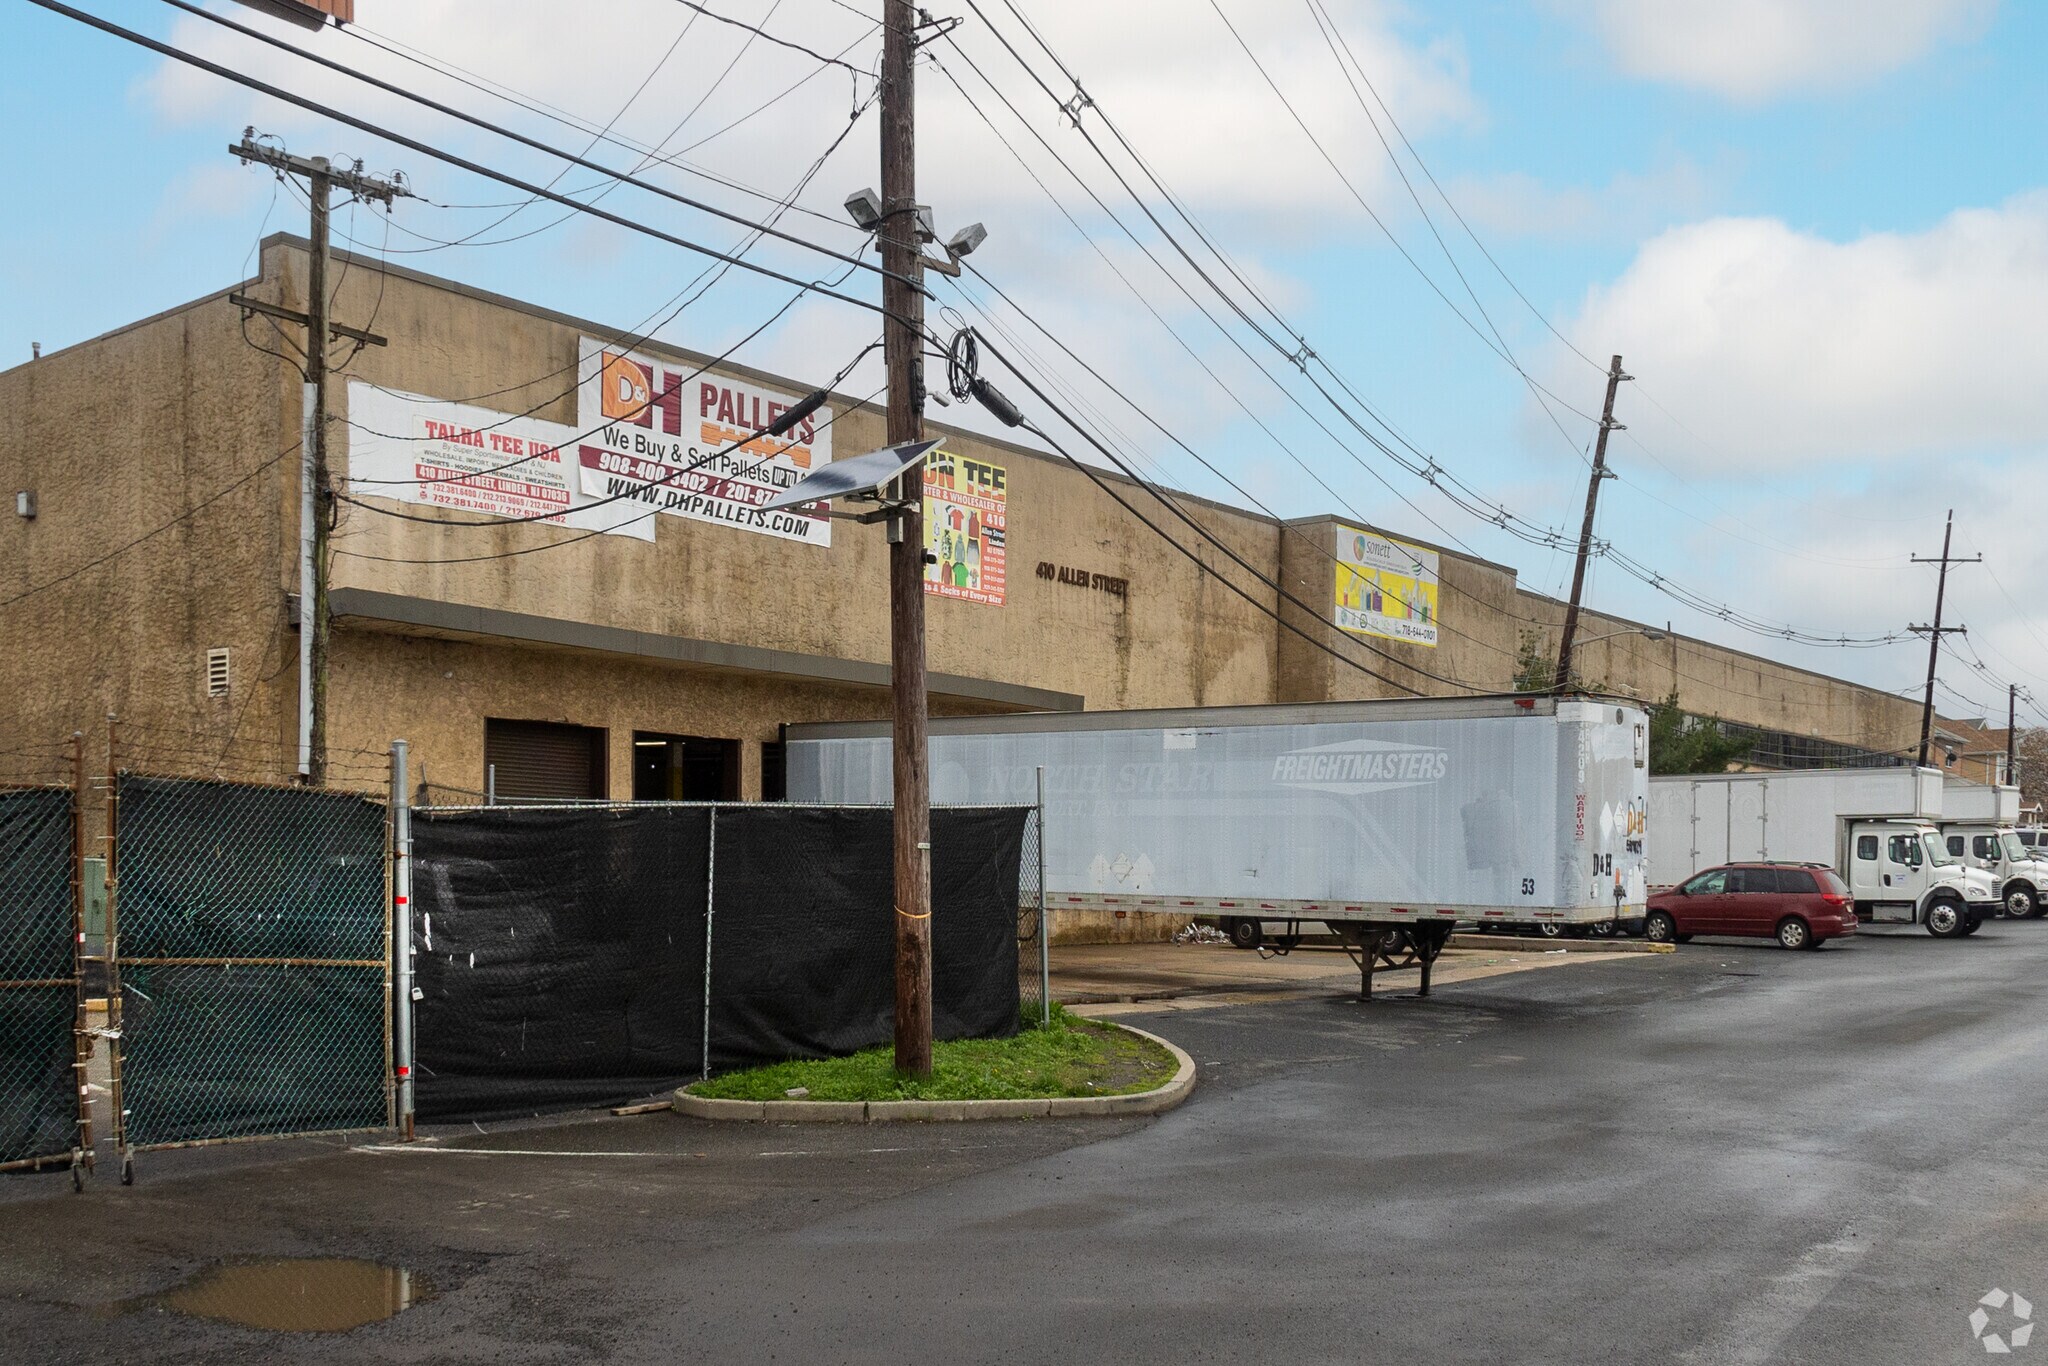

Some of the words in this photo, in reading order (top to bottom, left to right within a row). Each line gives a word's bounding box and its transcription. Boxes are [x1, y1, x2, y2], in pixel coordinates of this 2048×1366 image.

[424, 420, 484, 448] TALHA
[490, 432, 523, 456] TEE
[528, 441, 561, 464] USA
[442, 443, 451, 452] By
[453, 445, 473, 455] Super
[474, 448, 510, 462] Sportswear
[537, 461, 546, 469] NJ
[603, 425, 629, 449] We
[635, 432, 666, 463] Buy
[671, 443, 682, 463] &
[688, 447, 716, 471] Sell
[721, 455, 770, 483] Pallets
[773, 468, 785, 485] UP
[785, 471, 796, 487] TO
[420, 457, 450, 468] T-SHIRTS
[454, 463, 482, 473] HOODIES
[524, 476, 566, 489] SWEATSHIRTS
[424, 449, 464, 463] WHOLESALE,
[506, 465, 527, 475] LADIES
[534, 470, 563, 481] CHILDREN
[598, 452, 709, 491] 908-400-5402
[419, 465, 436, 479] 410
[437, 469, 463, 484] ALLEN
[497, 478, 529, 497] LINDEN,
[530, 485, 541, 498] NJ
[541, 487, 567, 503] 07036
[963, 459, 1005, 503] TEE
[432, 494, 496, 511] 732.381.7400
[606, 477, 810, 537] WWW.DHPALLETS.COM
[942, 491, 948, 500] &
[949, 492, 996, 512] WHOLESALER
[996, 503, 1006, 514] OF
[986, 513, 1005, 527] 410
[1366, 541, 1391, 559] sonett
[1035, 561, 1056, 581] 410
[1057, 566, 1090, 588] ALLEN
[1091, 573, 1130, 596] STREET
[940, 585, 960, 596] Socks
[961, 589, 968, 598] of
[969, 590, 987, 604] Every
[988, 594, 1002, 604] Size
[1272, 750, 1449, 781] FREIGHTMASTERS
[1592, 853, 1612, 877] D&H
[1521, 877, 1535, 896] 53
